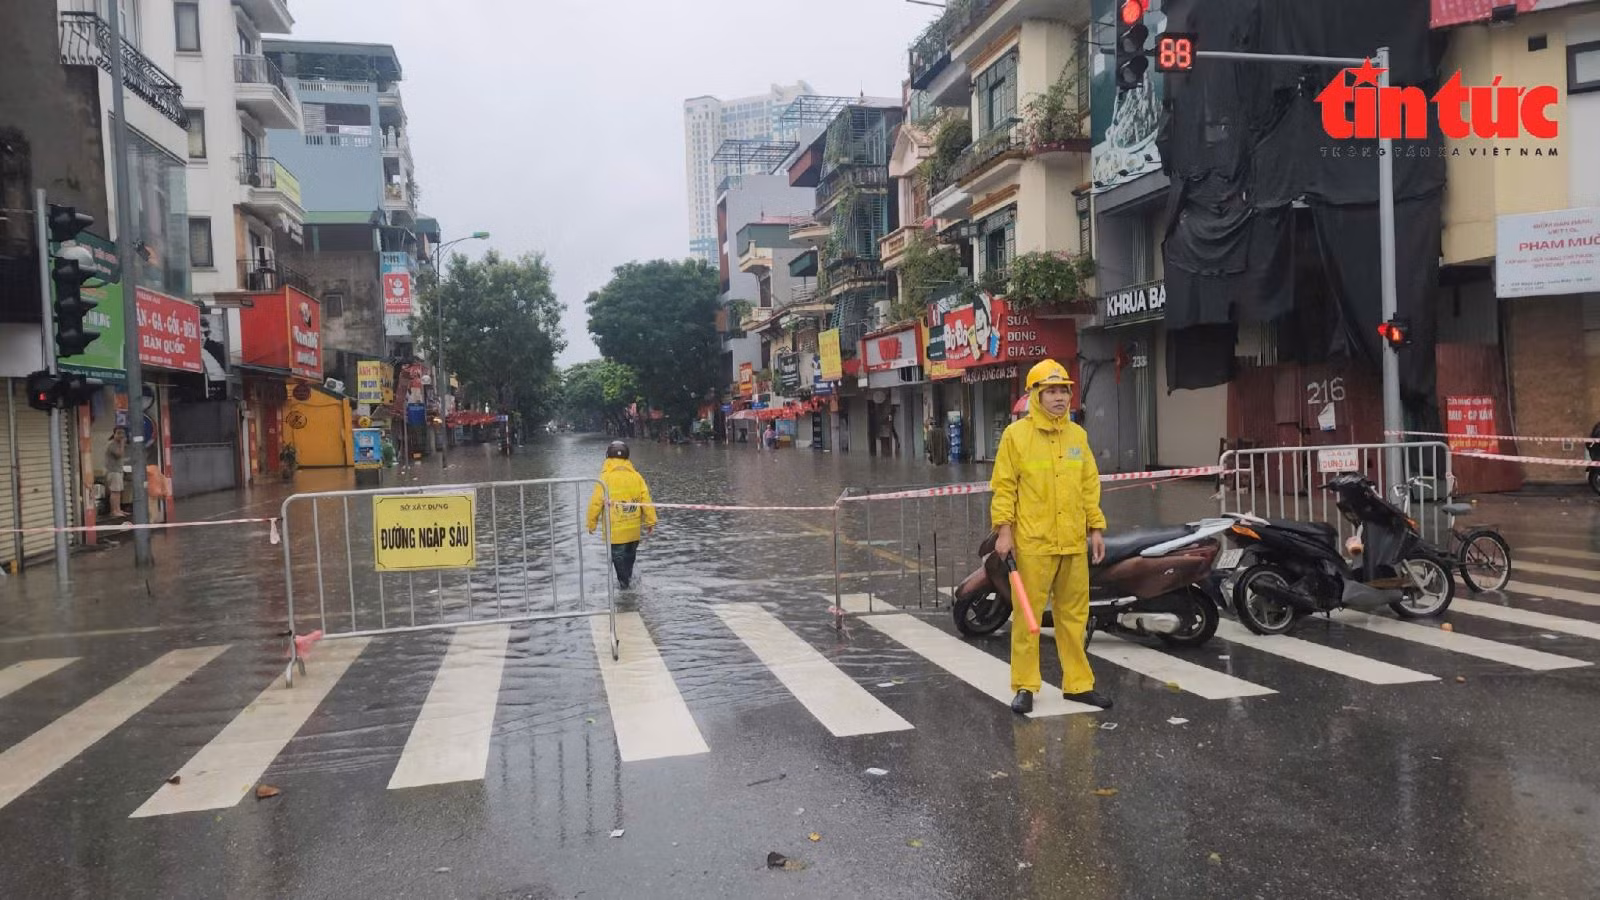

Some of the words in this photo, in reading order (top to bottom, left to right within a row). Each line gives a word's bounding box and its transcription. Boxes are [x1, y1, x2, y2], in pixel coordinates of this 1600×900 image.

[1107, 289, 1146, 317] KHRUA
[1028, 345, 1048, 357] 25K
[1307, 377, 1345, 405] 216
[381, 522, 415, 549] ĐƯỜNG
[419, 522, 446, 552] NGẬP
[449, 521, 468, 548] SÂU
